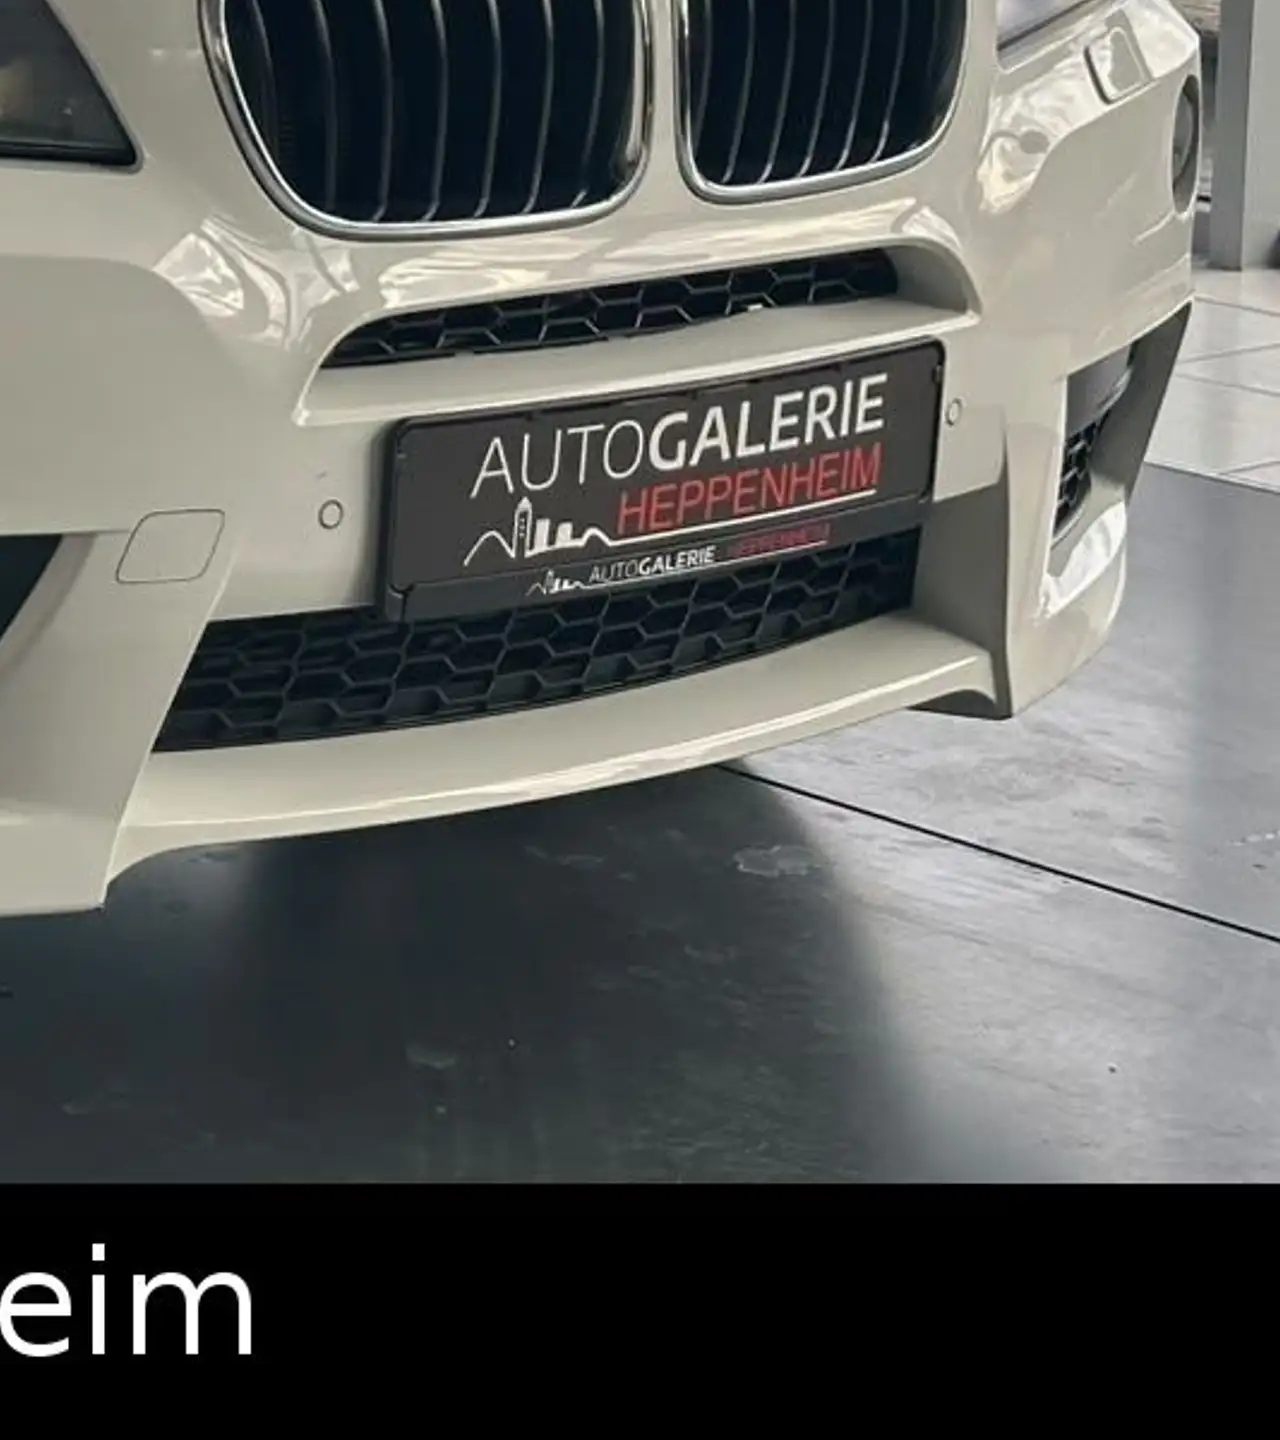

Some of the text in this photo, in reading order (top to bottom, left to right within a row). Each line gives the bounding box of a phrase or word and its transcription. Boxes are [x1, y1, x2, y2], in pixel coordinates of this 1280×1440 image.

[470, 372, 888, 499] AUTOGALERIE
[617, 442, 883, 536] HEPPENHEIM
[589, 544, 716, 582] AUTOGALERIE
